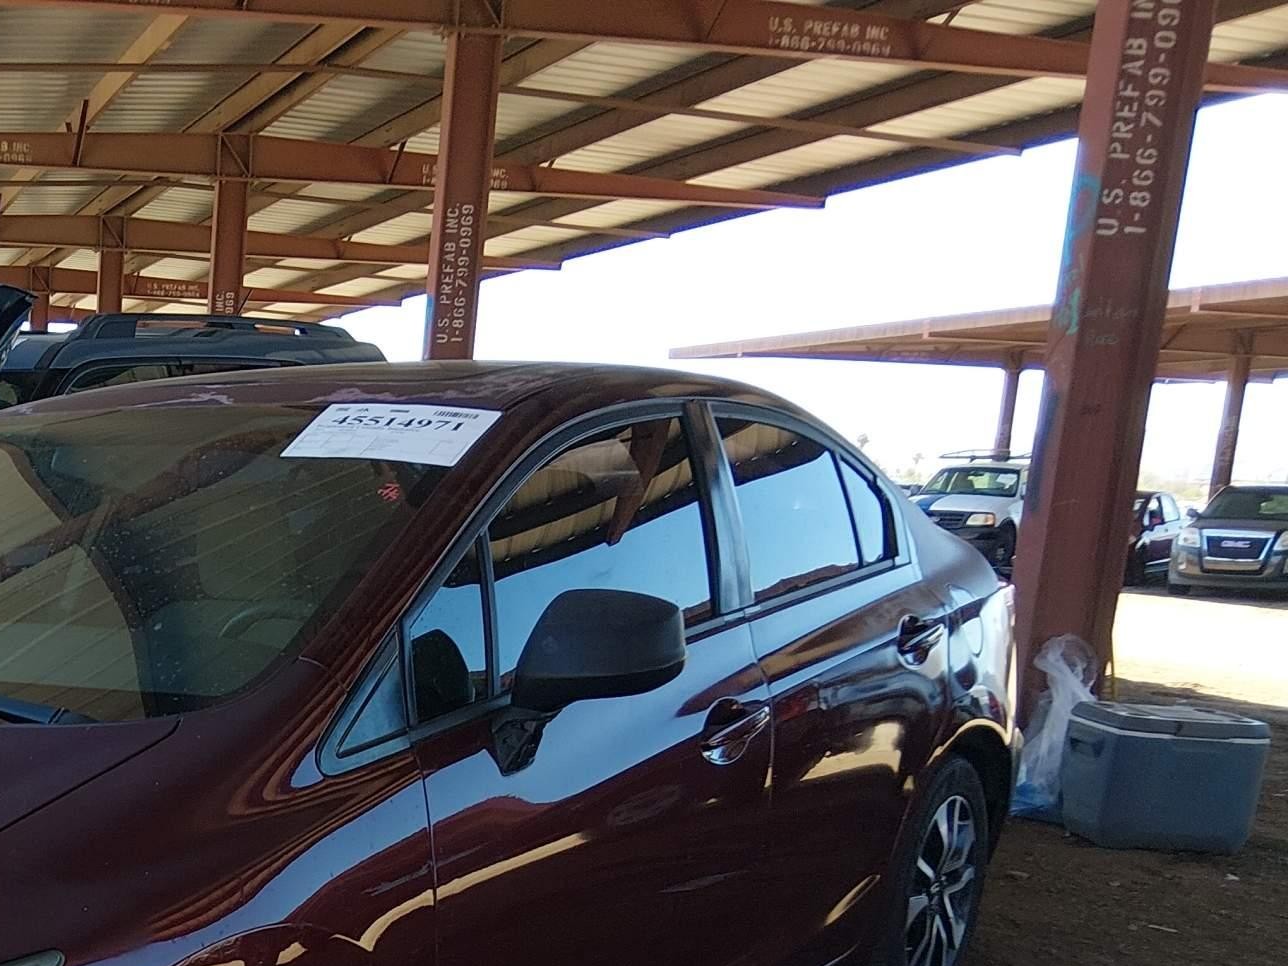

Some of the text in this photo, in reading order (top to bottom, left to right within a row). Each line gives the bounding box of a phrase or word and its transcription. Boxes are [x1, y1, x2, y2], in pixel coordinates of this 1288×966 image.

[803, 20, 860, 39] PREFAB
[1109, 37, 1147, 159] PREFAB
[1123, 0, 1182, 234] 1-866-799-09
[445, 202, 460, 233] INC.
[440, 241, 456, 304] PREFAB
[450, 204, 474, 342] 1-866-799-0969
[332, 415, 464, 431] 45514971
